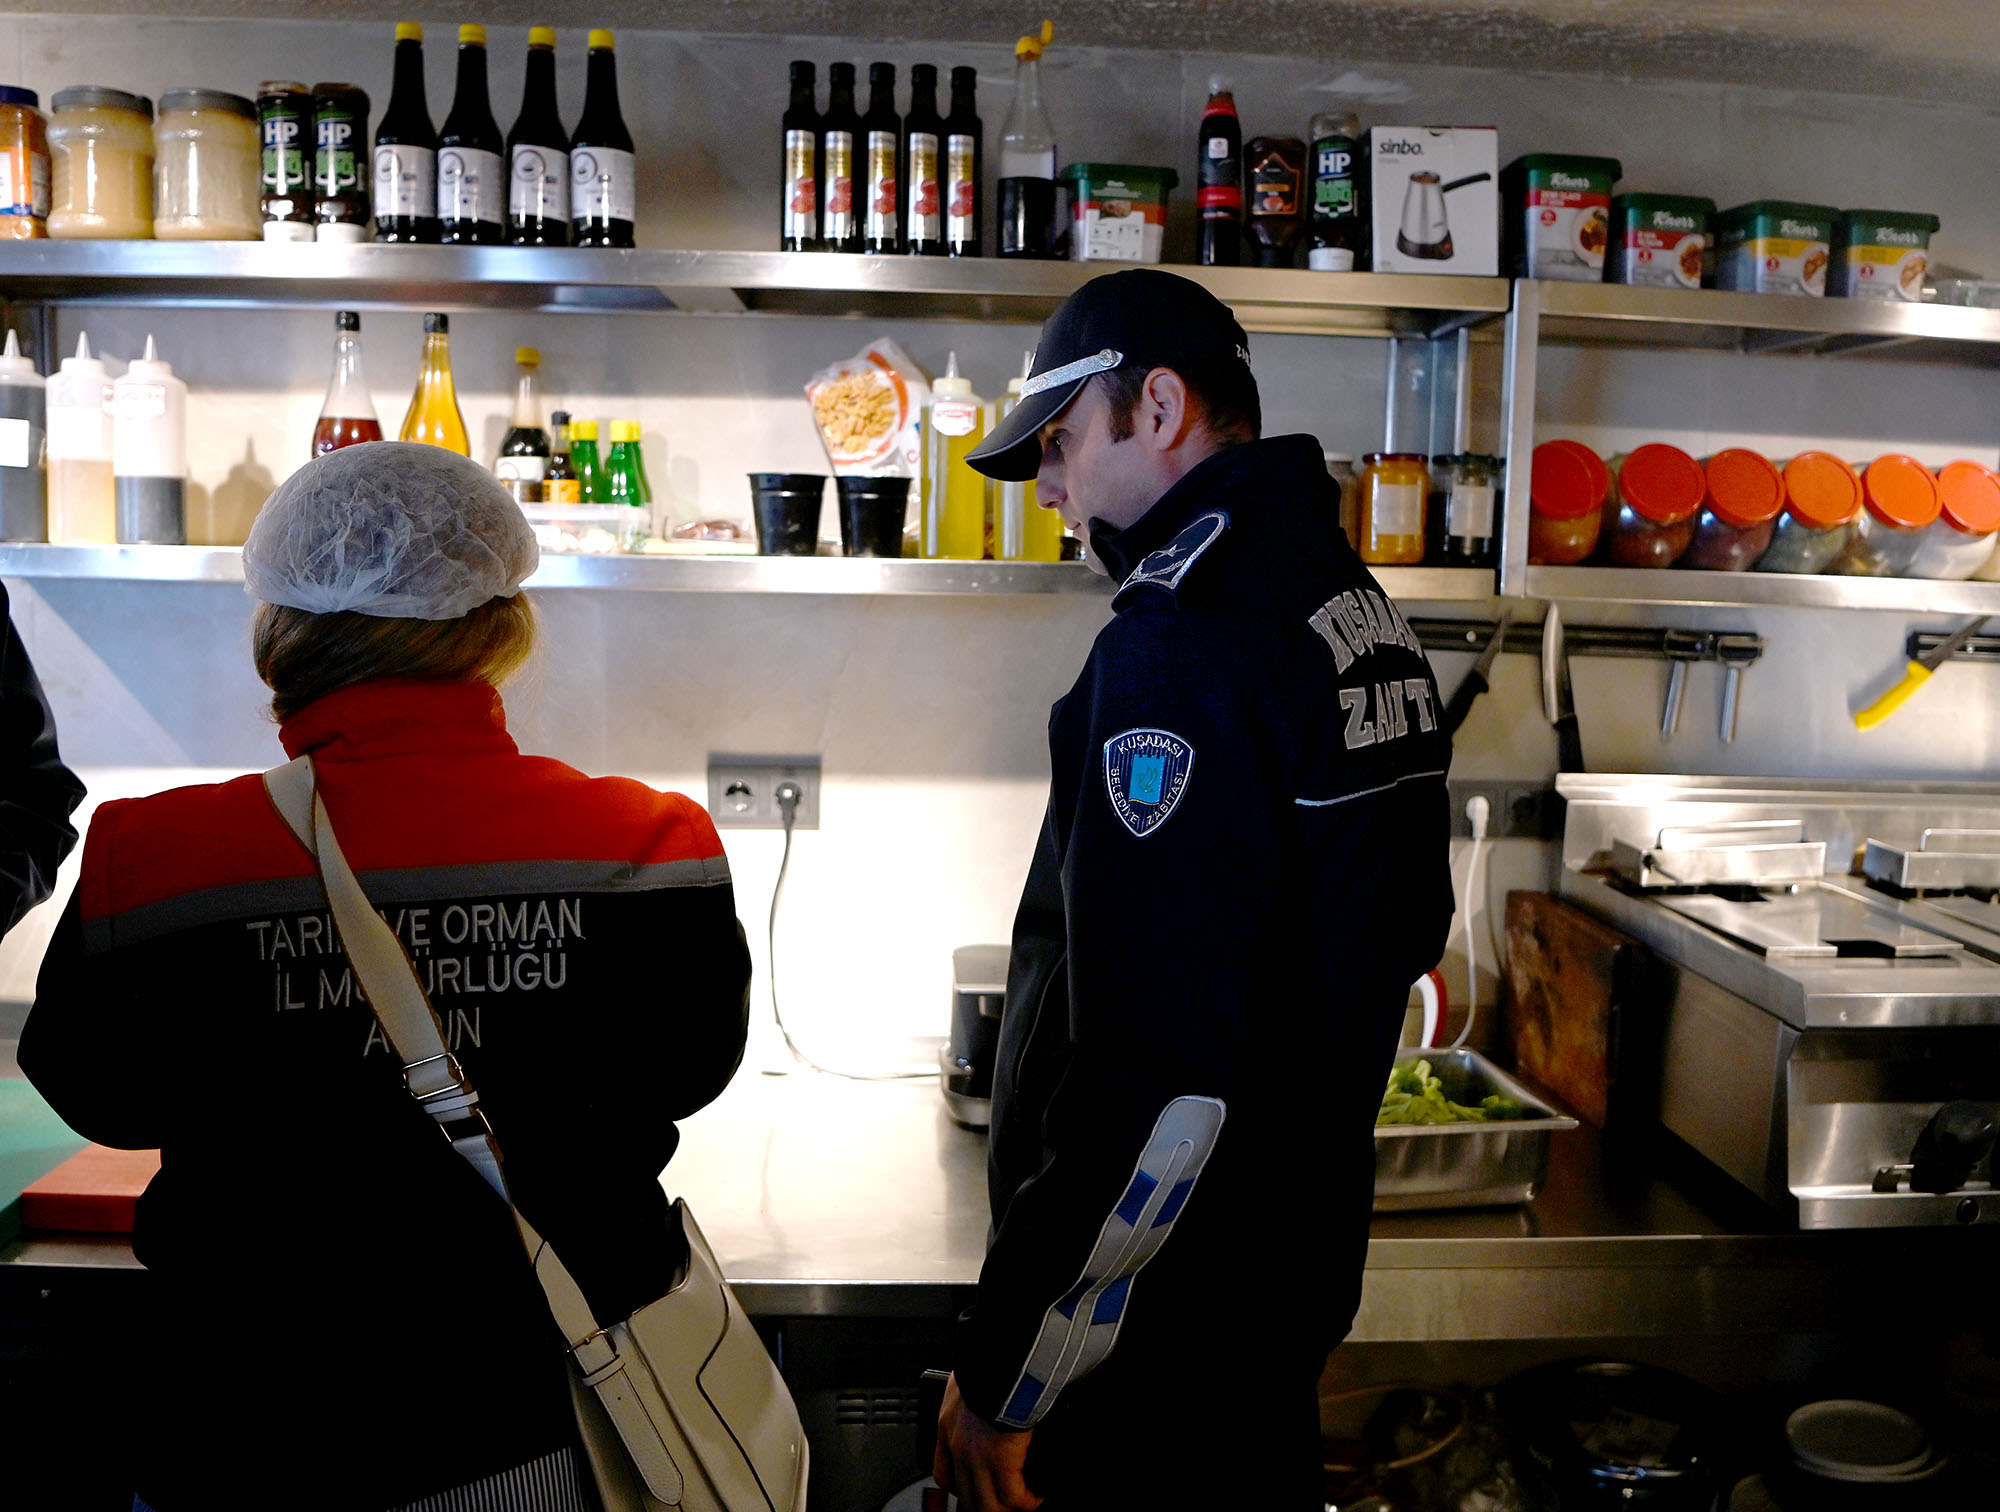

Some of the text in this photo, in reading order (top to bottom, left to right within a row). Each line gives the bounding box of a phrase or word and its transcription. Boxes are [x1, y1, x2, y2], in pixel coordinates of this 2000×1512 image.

[264, 121, 299, 145] HP
[317, 122, 352, 145] HP
[1318, 152, 1351, 174] HP
[1146, 772, 1185, 825] ZABITASI
[246, 913, 341, 961] TARI
[441, 898, 582, 945] ORMAN
[275, 939, 567, 1012] İL MÜRLÜĞÜ
[363, 1006, 481, 1057] AIN
